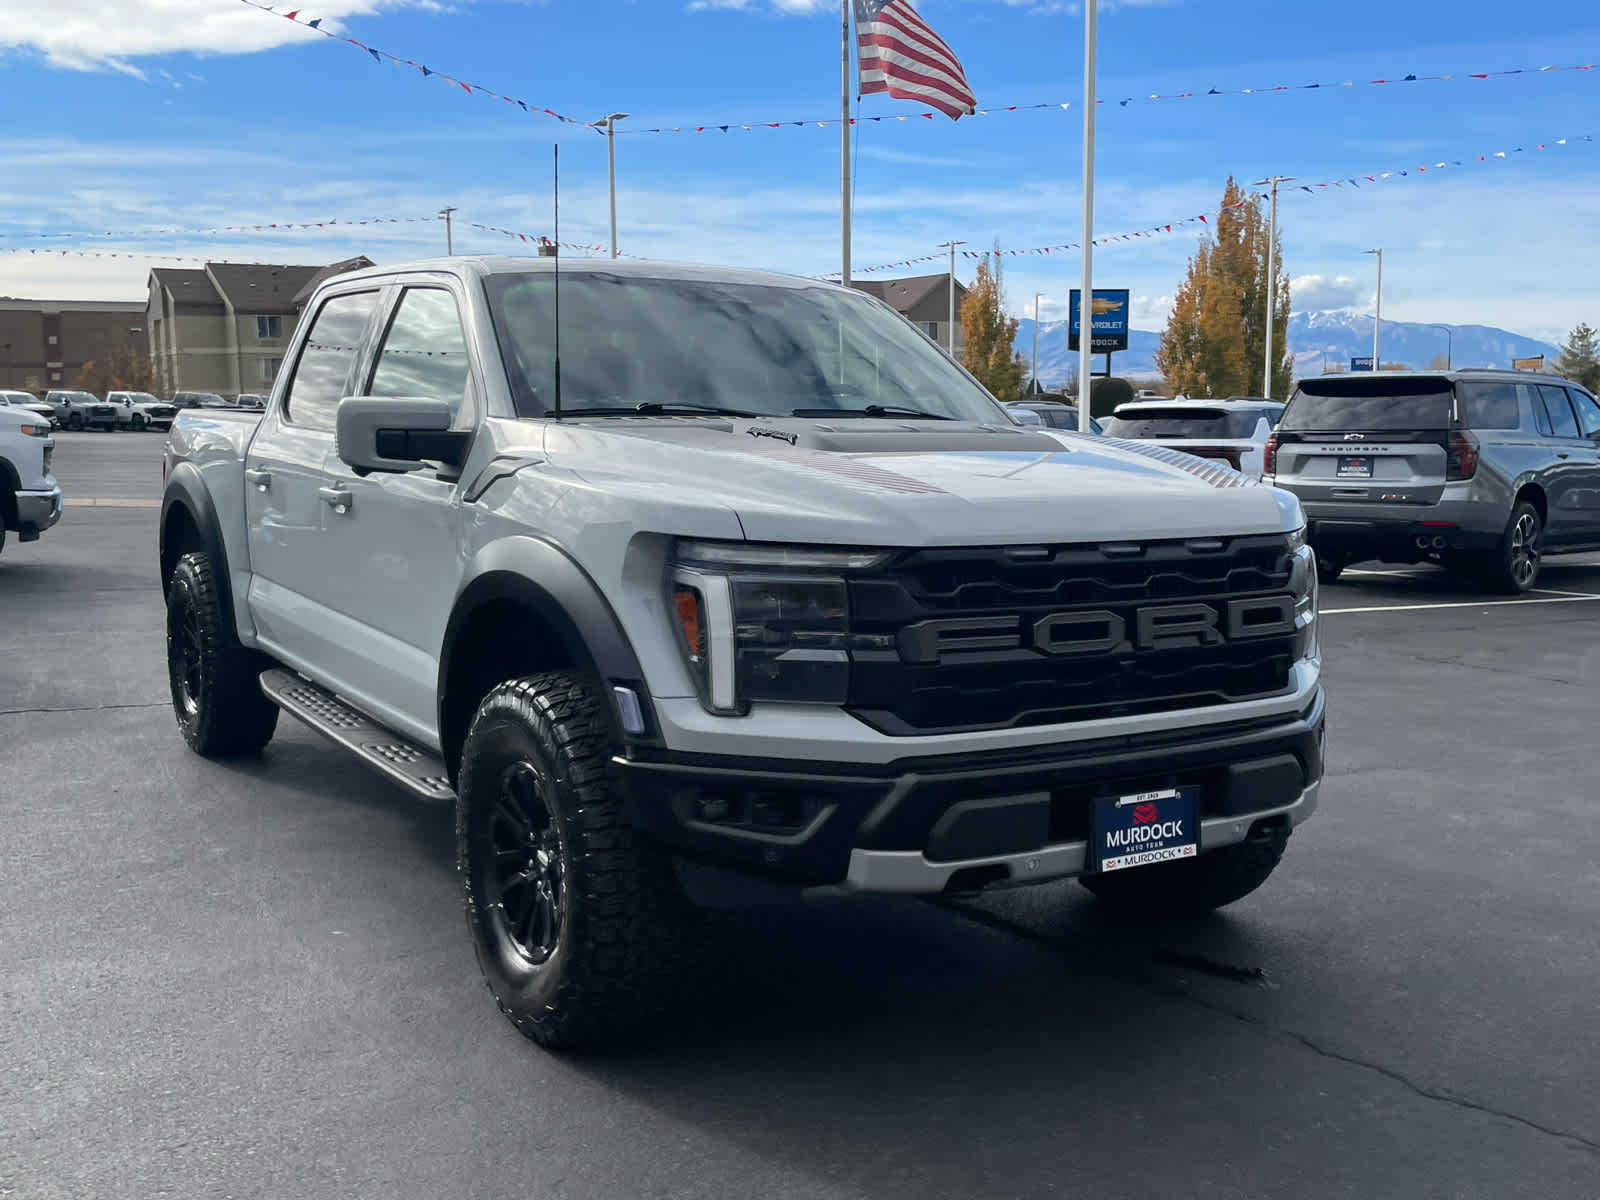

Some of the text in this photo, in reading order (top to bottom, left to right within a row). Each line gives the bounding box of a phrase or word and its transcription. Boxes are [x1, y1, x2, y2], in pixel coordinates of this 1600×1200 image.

[1074, 321, 1122, 329] CVROLET
[904, 595, 1296, 664] FORD
[1106, 820, 1183, 848] MURDOCK
[1126, 840, 1164, 853] AUTO TEAM
[1124, 848, 1176, 866] MURDOCK
